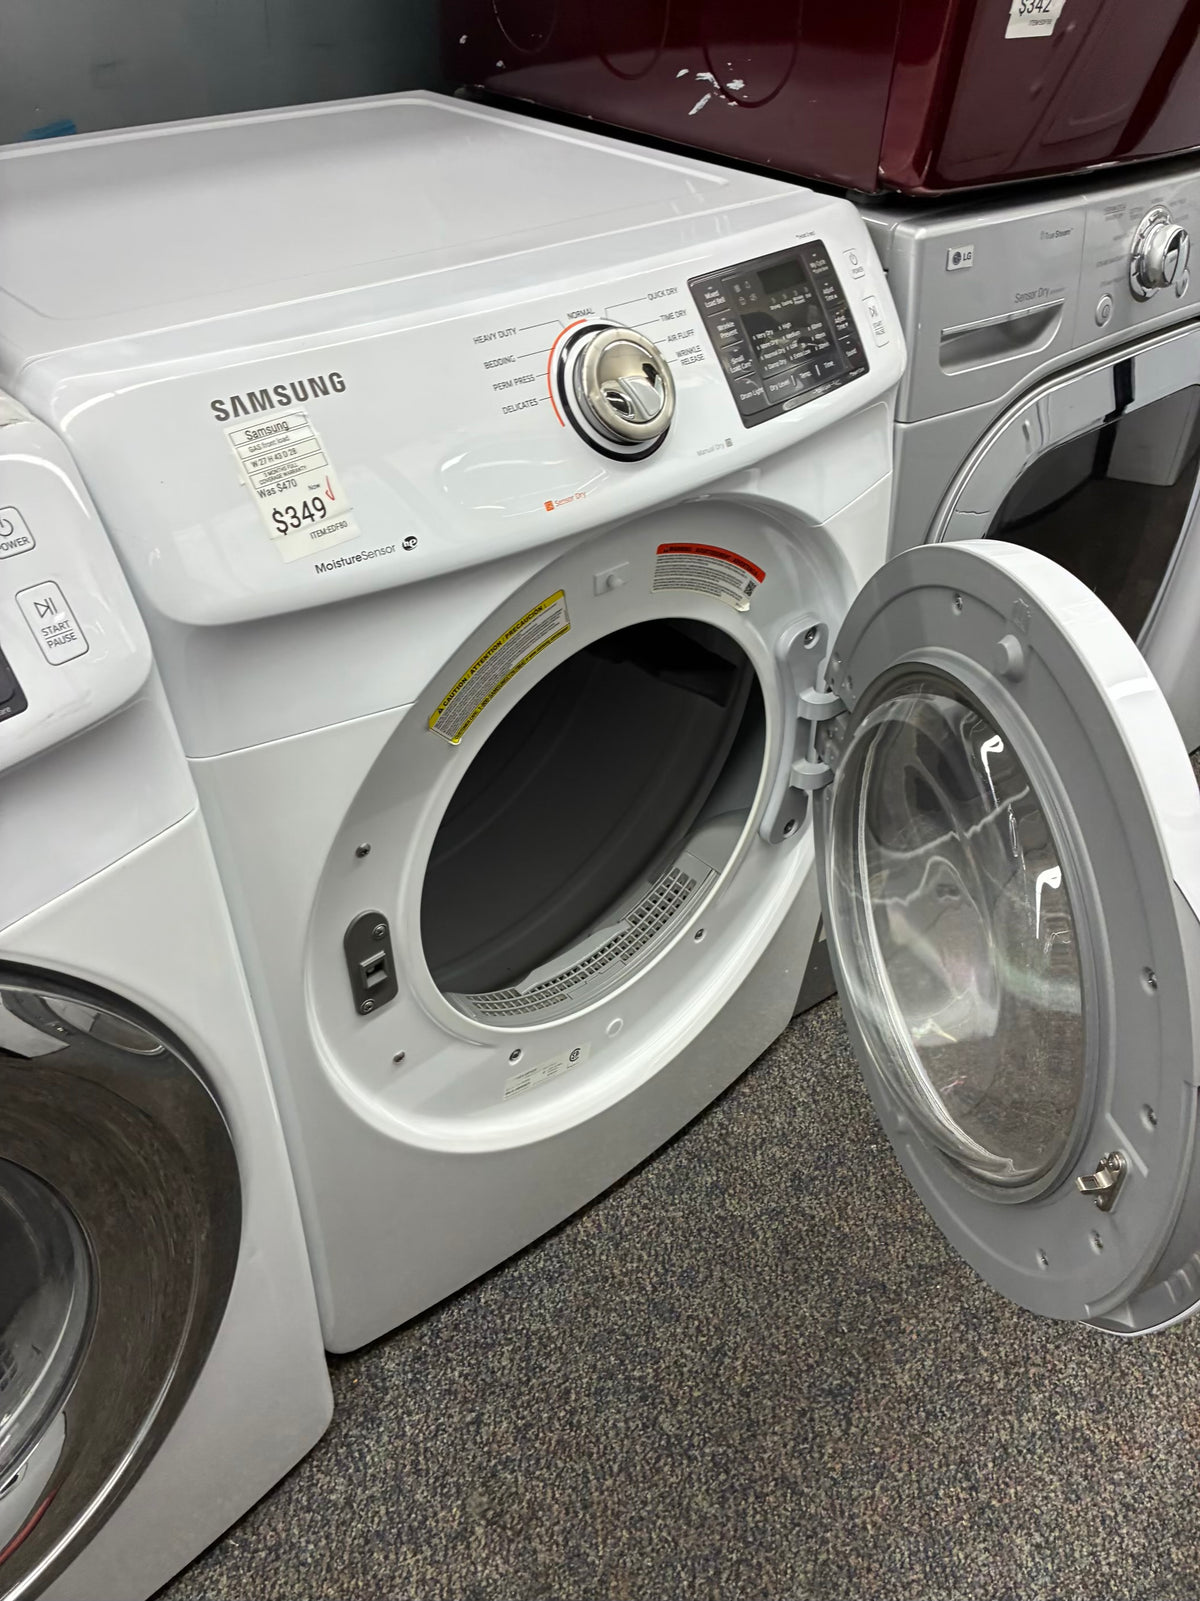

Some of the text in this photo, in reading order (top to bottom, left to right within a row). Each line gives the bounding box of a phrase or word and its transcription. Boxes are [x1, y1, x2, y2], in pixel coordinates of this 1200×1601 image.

[963, 252, 972, 261] LG
[648, 287, 678, 300] QUICK DRY
[1014, 290, 1037, 303] Sensor
[1037, 287, 1049, 298] Dry
[567, 308, 595, 319] NORMAL
[659, 309, 687, 321] TIME DRY
[473, 328, 517, 344] HEAVY DUTY
[677, 329, 694, 339] FLUFF
[676, 345, 701, 357] WRINKLE
[483, 354, 516, 370] BEDDING
[680, 353, 704, 366] RELEASE
[492, 374, 535, 391] PERM PRESS
[210, 372, 346, 422] SAMSUNG
[502, 398, 538, 414] DELICATES
[244, 421, 290, 441] Samsung
[248, 435, 290, 453] GAS front load
[715, 442, 725, 452] Dry
[259, 457, 267, 465] 27
[260, 465, 307, 485] COVERAGE WARRANTY
[268, 466, 286, 476] MONTHS
[257, 478, 297, 498] Was $470
[554, 491, 586, 507] Sensor Dry
[272, 496, 327, 536] $349
[315, 544, 396, 574] MoistureSensor
[41, 620, 71, 636] START
[46, 632, 77, 649] PAUSE
[443, 677, 468, 707] CAUTION
[470, 641, 502, 674] ATTENTION
